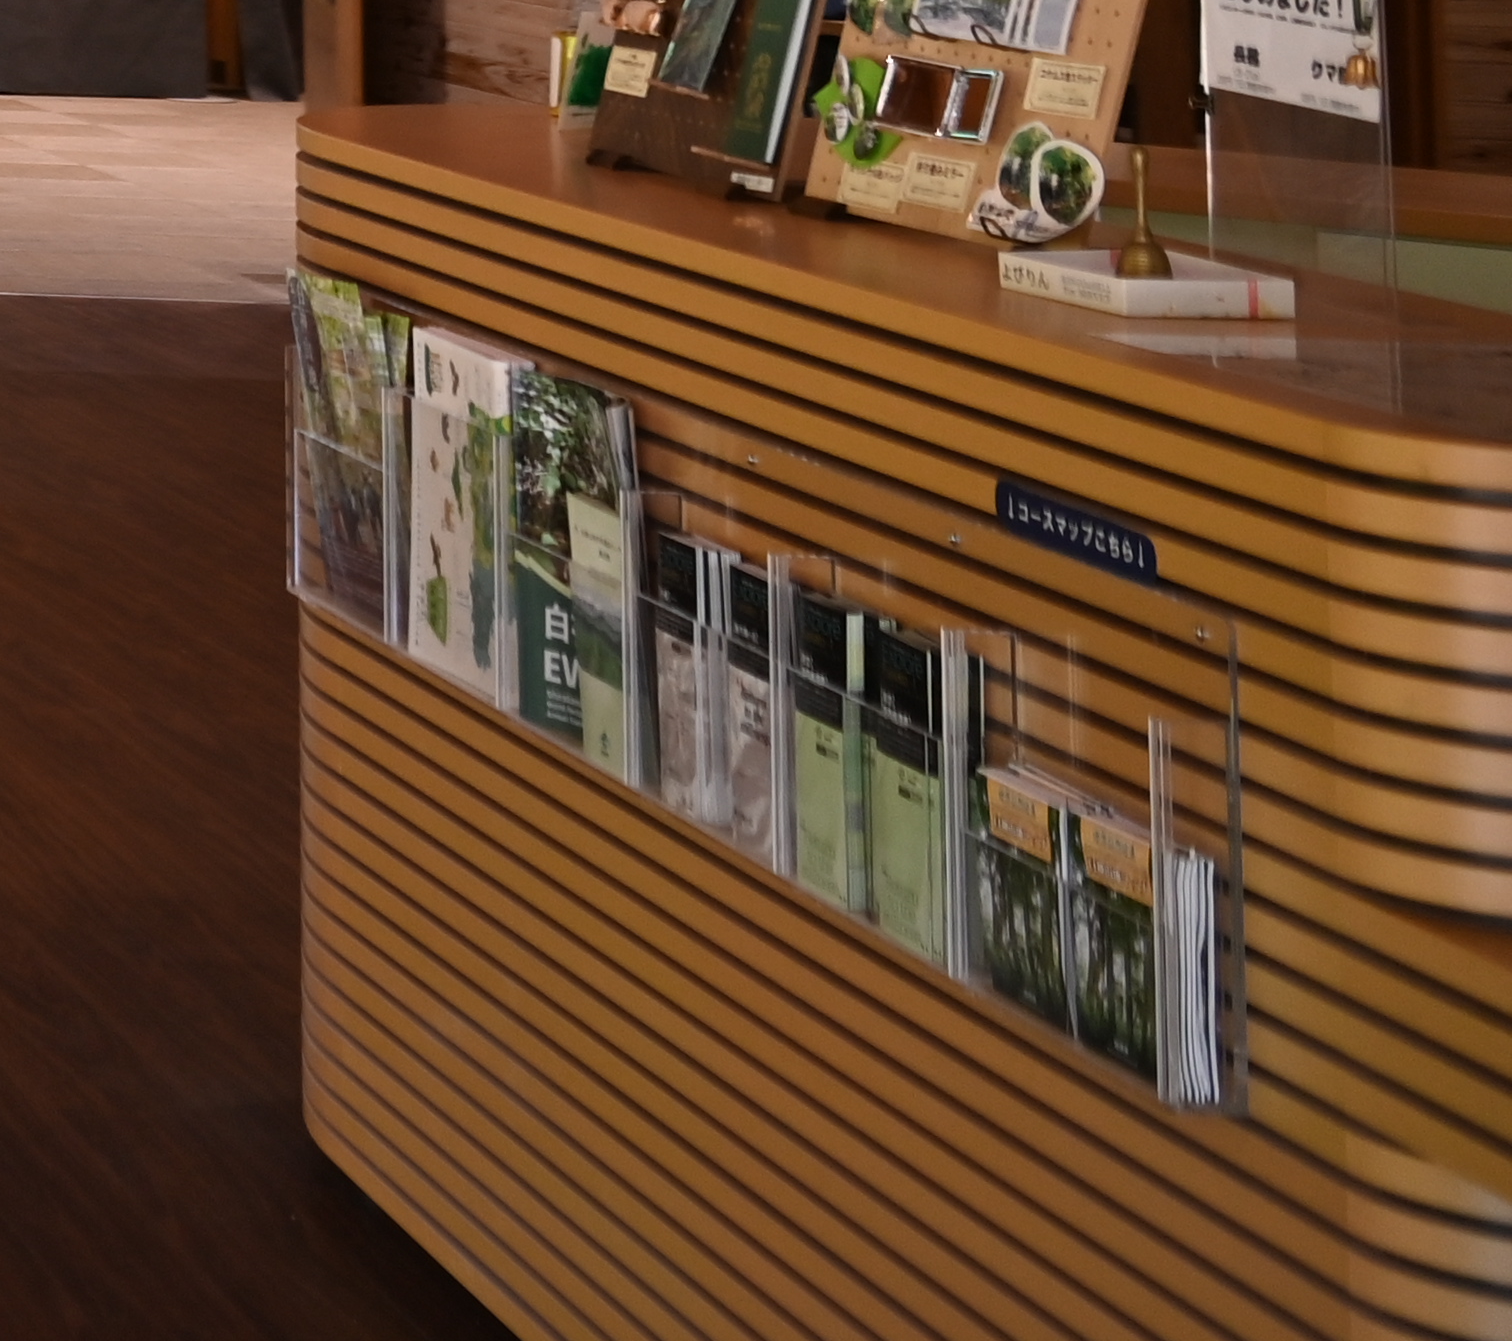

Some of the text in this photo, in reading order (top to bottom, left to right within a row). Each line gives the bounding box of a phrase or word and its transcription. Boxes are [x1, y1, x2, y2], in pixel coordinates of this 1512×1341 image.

[1018, 501, 1134, 564] コースマップこちら
[545, 601, 576, 645] 白
